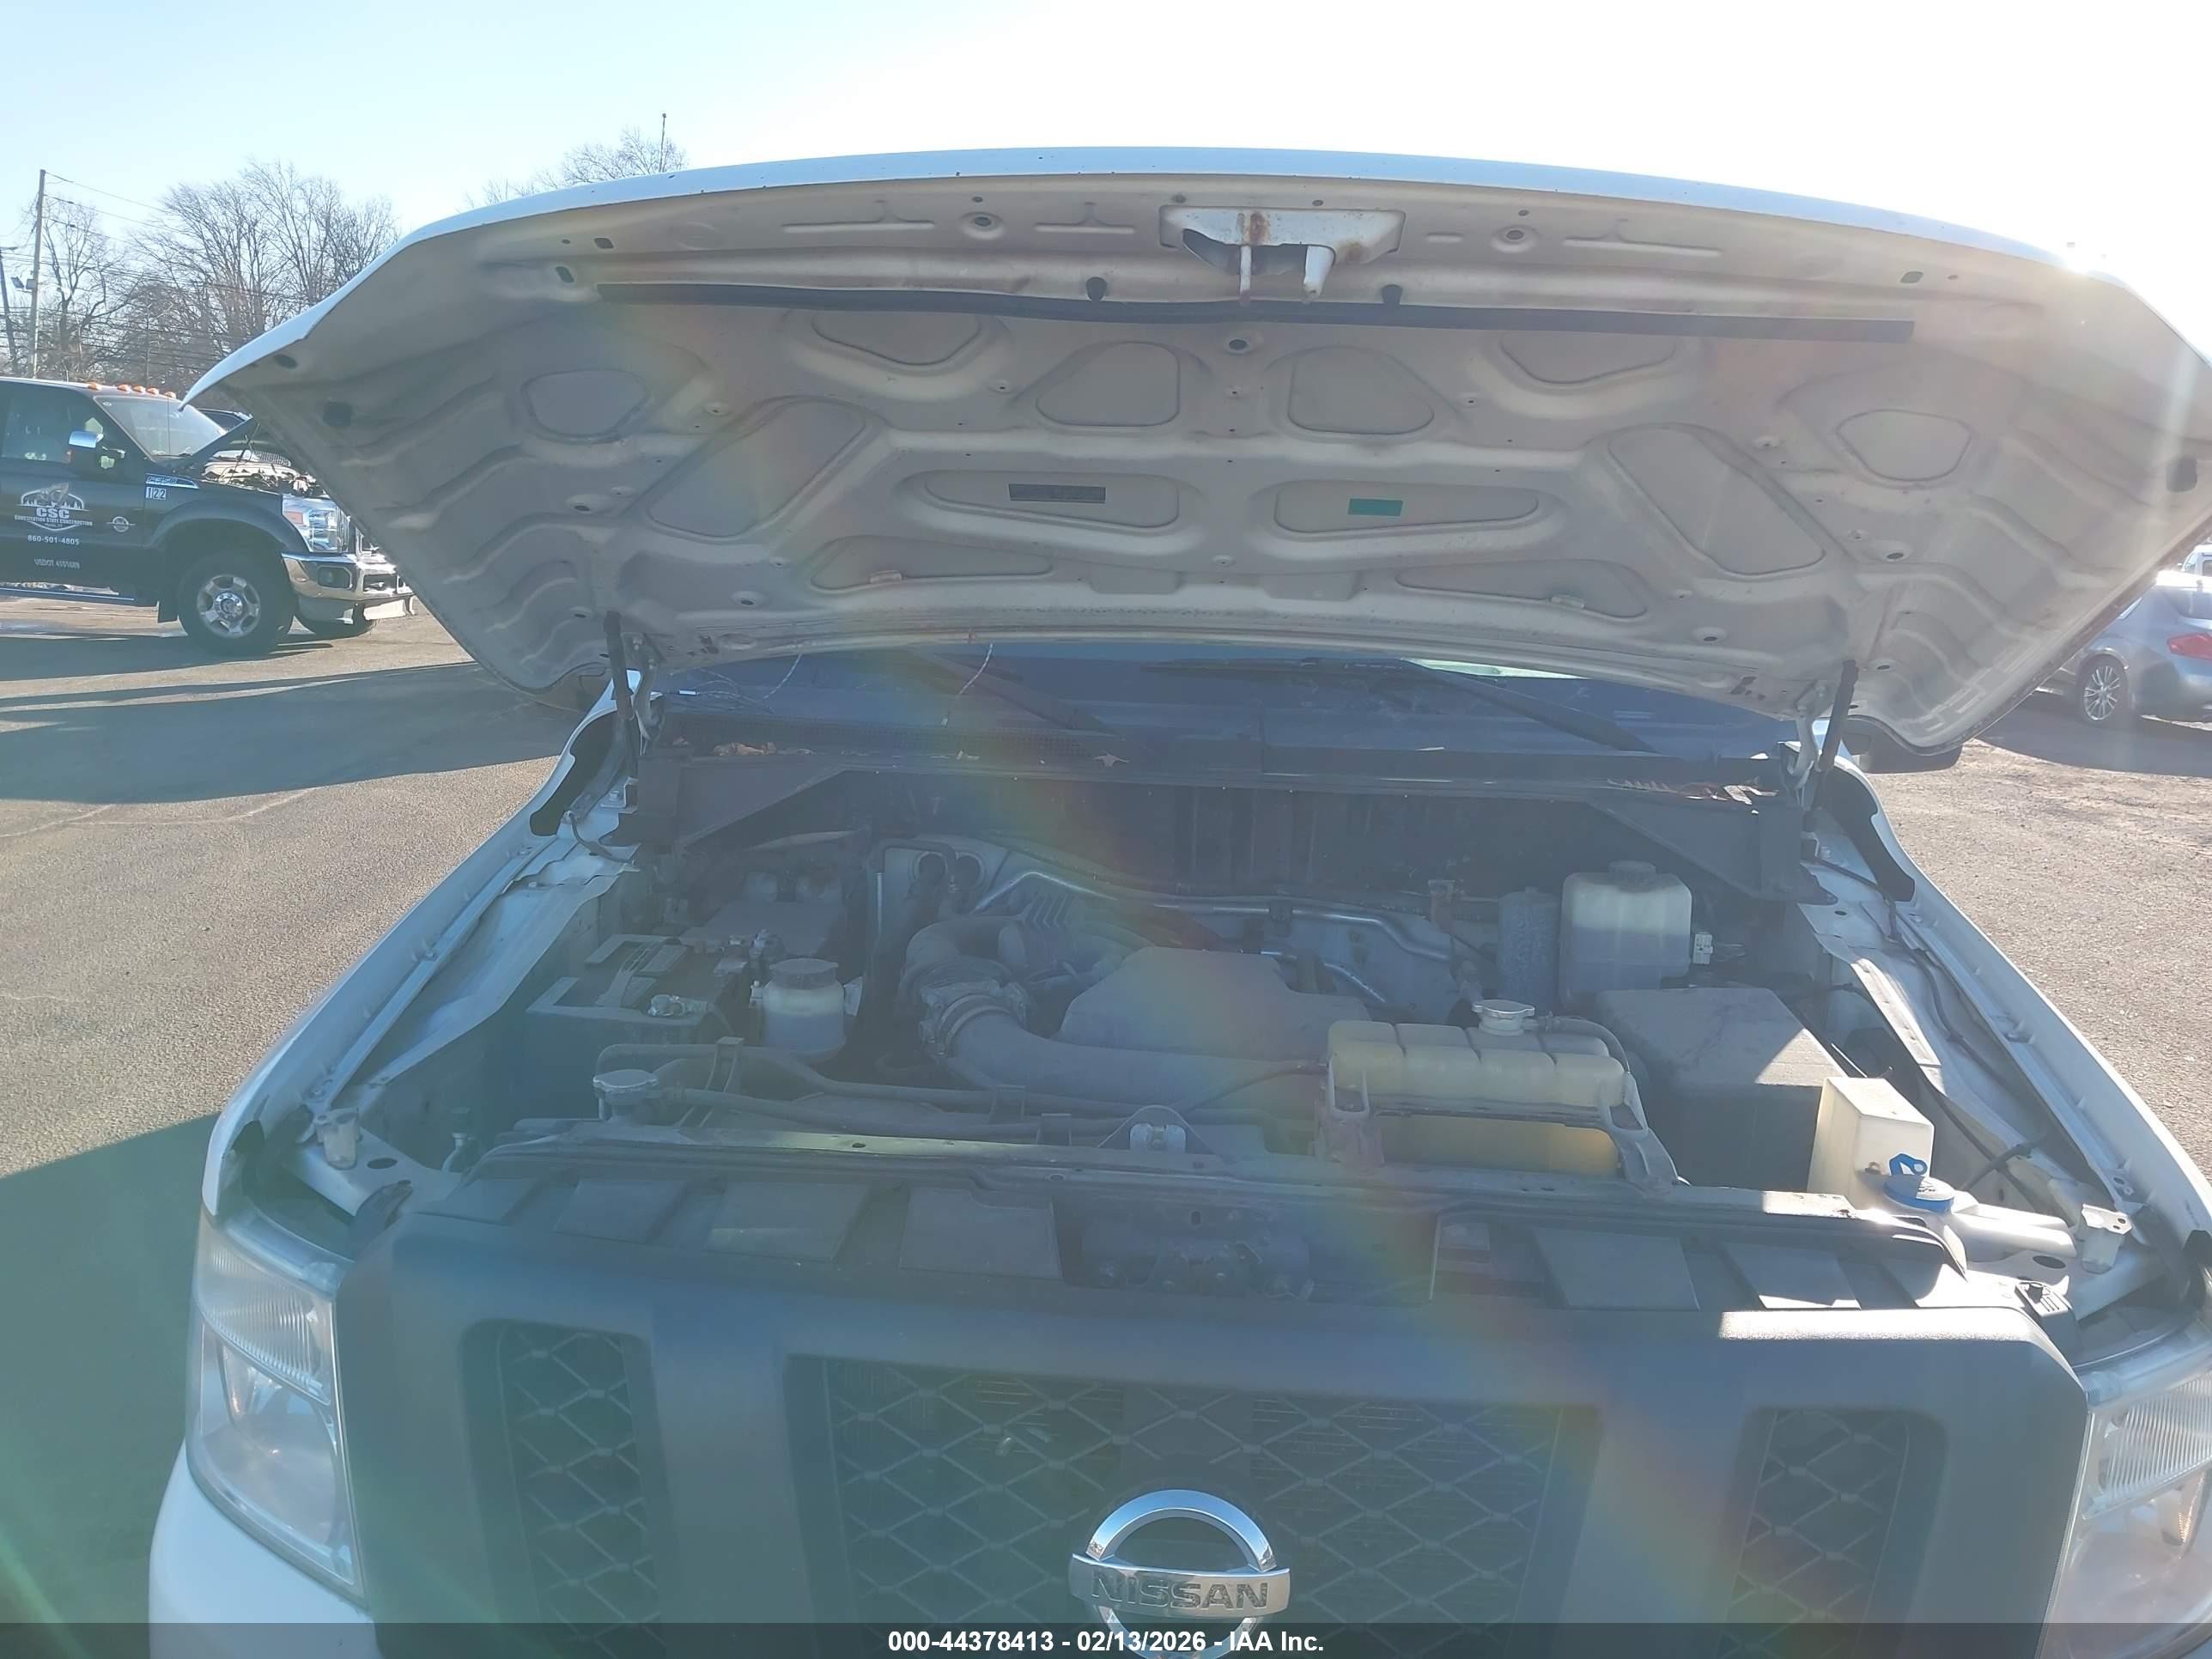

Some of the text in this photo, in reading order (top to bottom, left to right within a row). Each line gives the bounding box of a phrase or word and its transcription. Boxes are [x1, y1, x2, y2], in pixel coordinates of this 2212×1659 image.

[147, 487, 166, 500] 122
[36, 507, 70, 520] CSC
[27, 535, 80, 545] 860-501-4805
[1091, 1568, 1268, 1610] NISSAN
